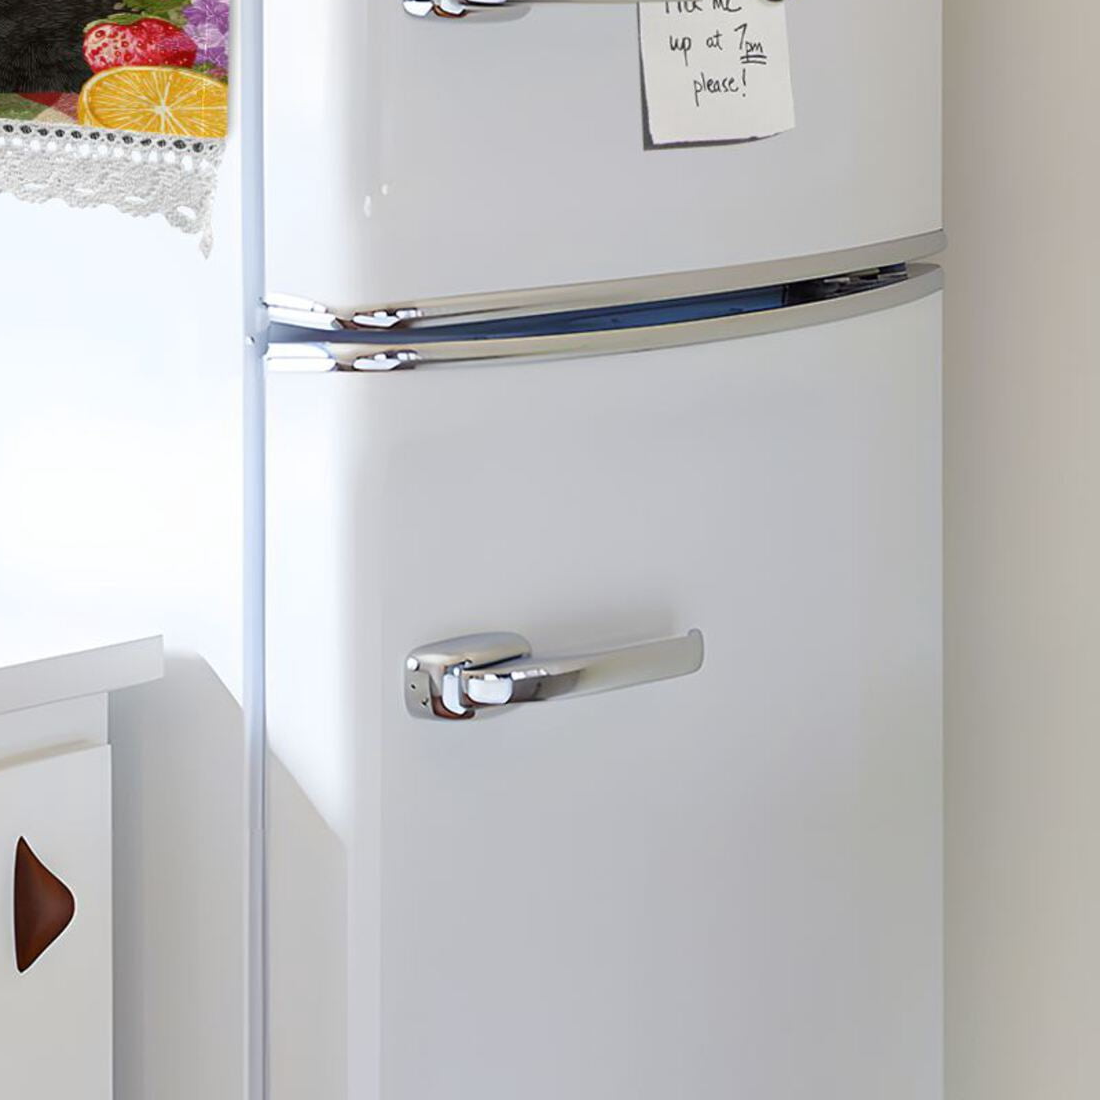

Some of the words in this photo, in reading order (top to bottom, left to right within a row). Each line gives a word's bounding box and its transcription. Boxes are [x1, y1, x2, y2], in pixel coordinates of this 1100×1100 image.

[669, 36, 692, 66] up
[706, 30, 722, 50] at
[694, 68, 747, 107] please!
